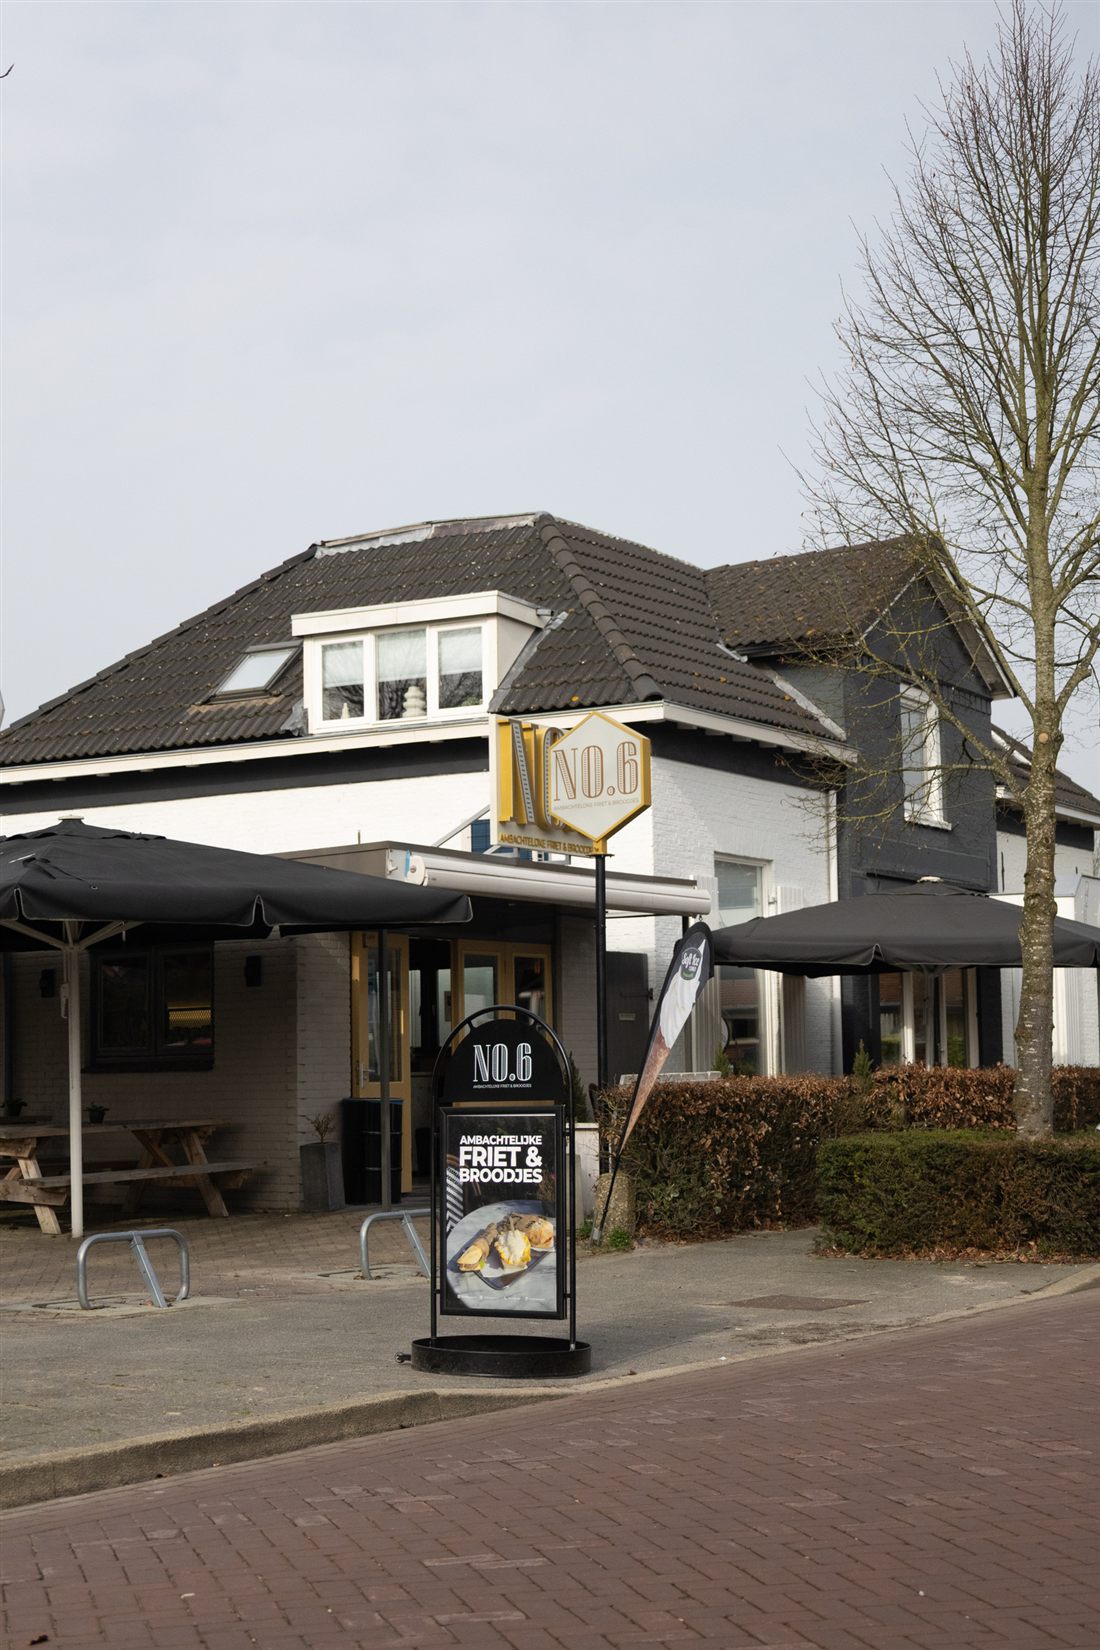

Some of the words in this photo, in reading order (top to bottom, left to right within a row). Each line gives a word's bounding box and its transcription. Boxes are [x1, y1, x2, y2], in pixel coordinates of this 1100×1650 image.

[553, 741, 639, 801] NO.6
[500, 833, 546, 850] AMBACHTELIJKE
[547, 840, 562, 852] FRIET
[682, 953, 692, 968] Soft
[473, 1043, 532, 1082] NO.6
[459, 1135, 542, 1145] AMBACHTELIJKE
[459, 1146, 521, 1167] FRIET
[525, 1146, 543, 1167] &
[459, 1168, 543, 1183] BROODJES
